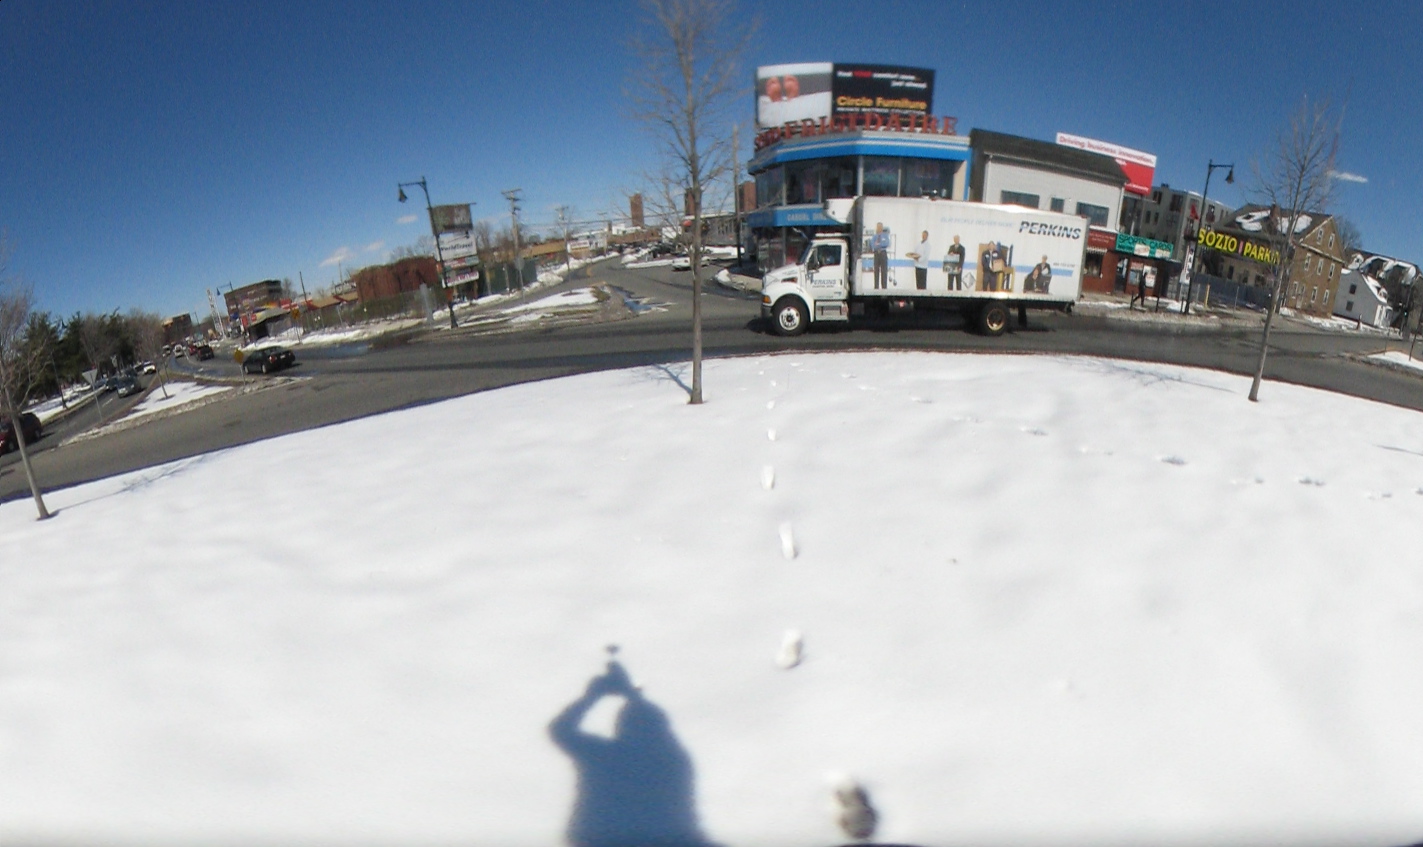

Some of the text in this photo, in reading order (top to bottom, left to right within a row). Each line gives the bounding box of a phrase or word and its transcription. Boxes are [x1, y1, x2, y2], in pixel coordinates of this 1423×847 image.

[837, 96, 927, 110] Circle Furniture
[783, 113, 958, 139] FRIGIDAIRE
[1060, 135, 1086, 149] Driving
[1087, 140, 1117, 154] business
[1019, 220, 1082, 240] PERKINS
[1198, 228, 1238, 253] SOZIO
